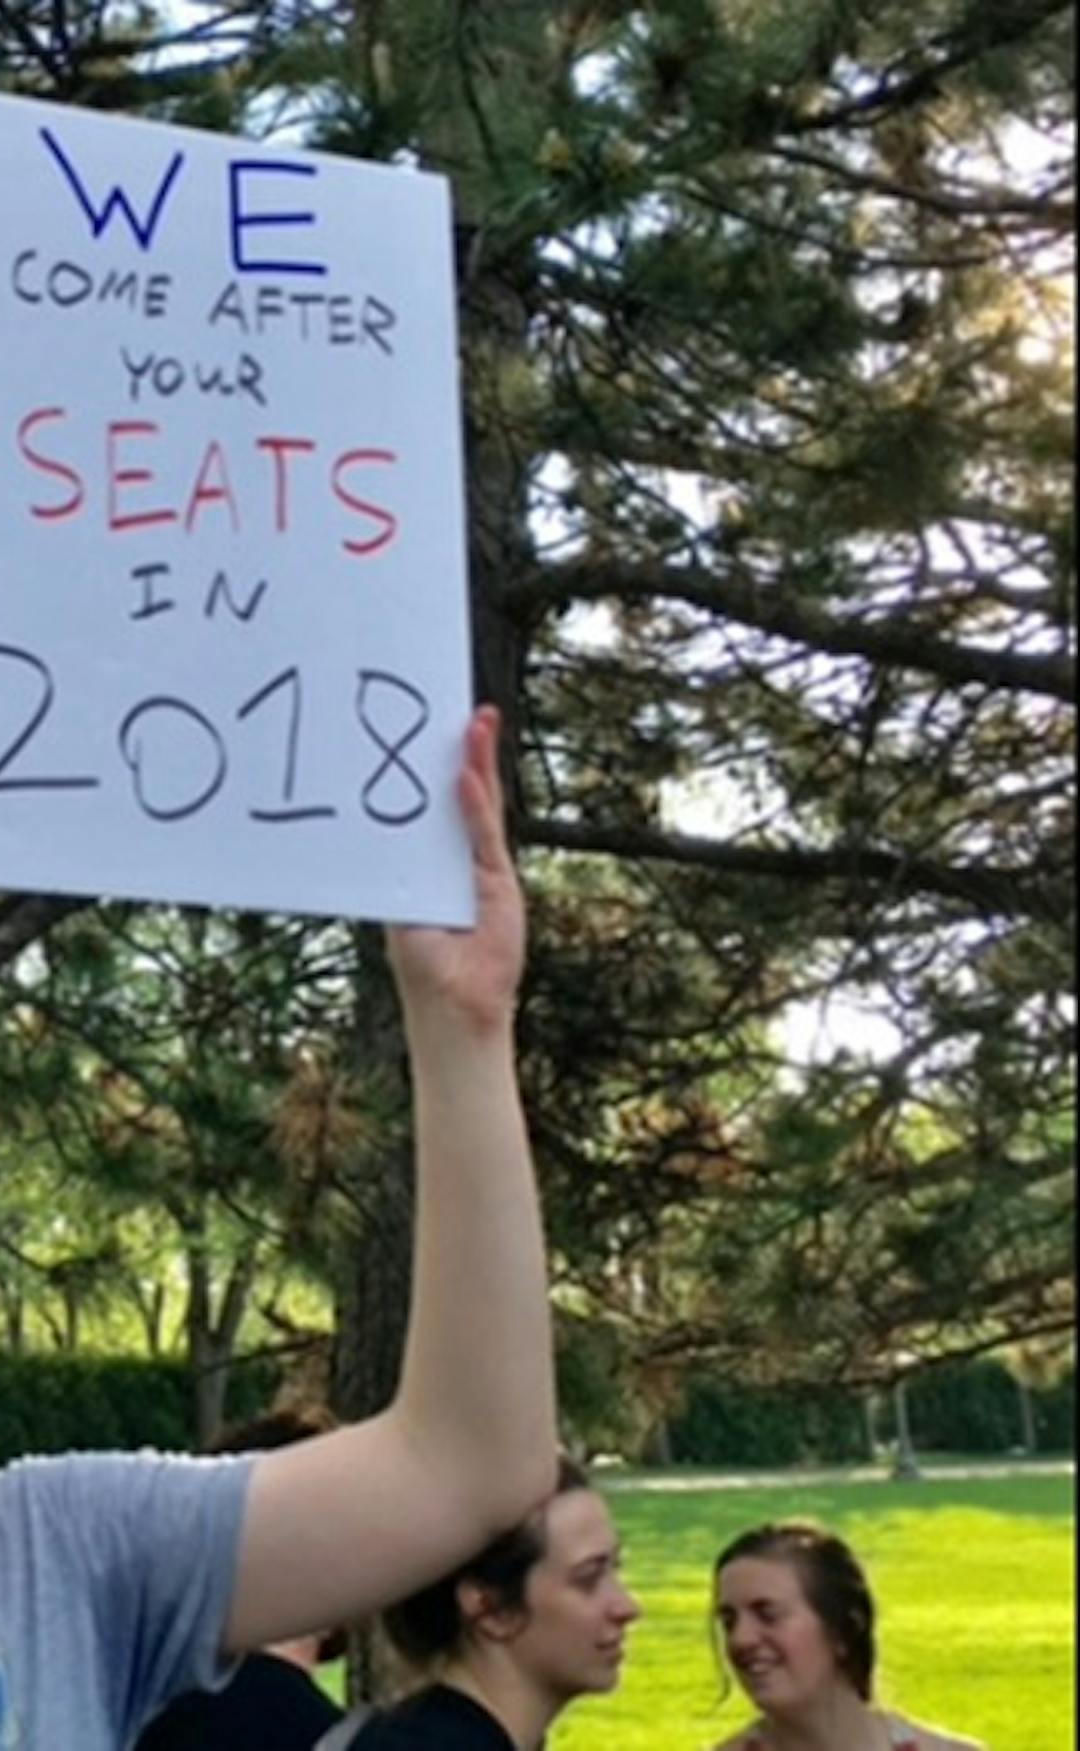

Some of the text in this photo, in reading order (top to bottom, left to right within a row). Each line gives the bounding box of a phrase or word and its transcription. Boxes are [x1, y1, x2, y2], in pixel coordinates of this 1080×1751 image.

[39, 126, 329, 275] WE
[12, 249, 397, 356] COME AFTER
[122, 346, 267, 406] YOUR
[18, 406, 398, 556] SEATS
[130, 562, 269, 623] IN
